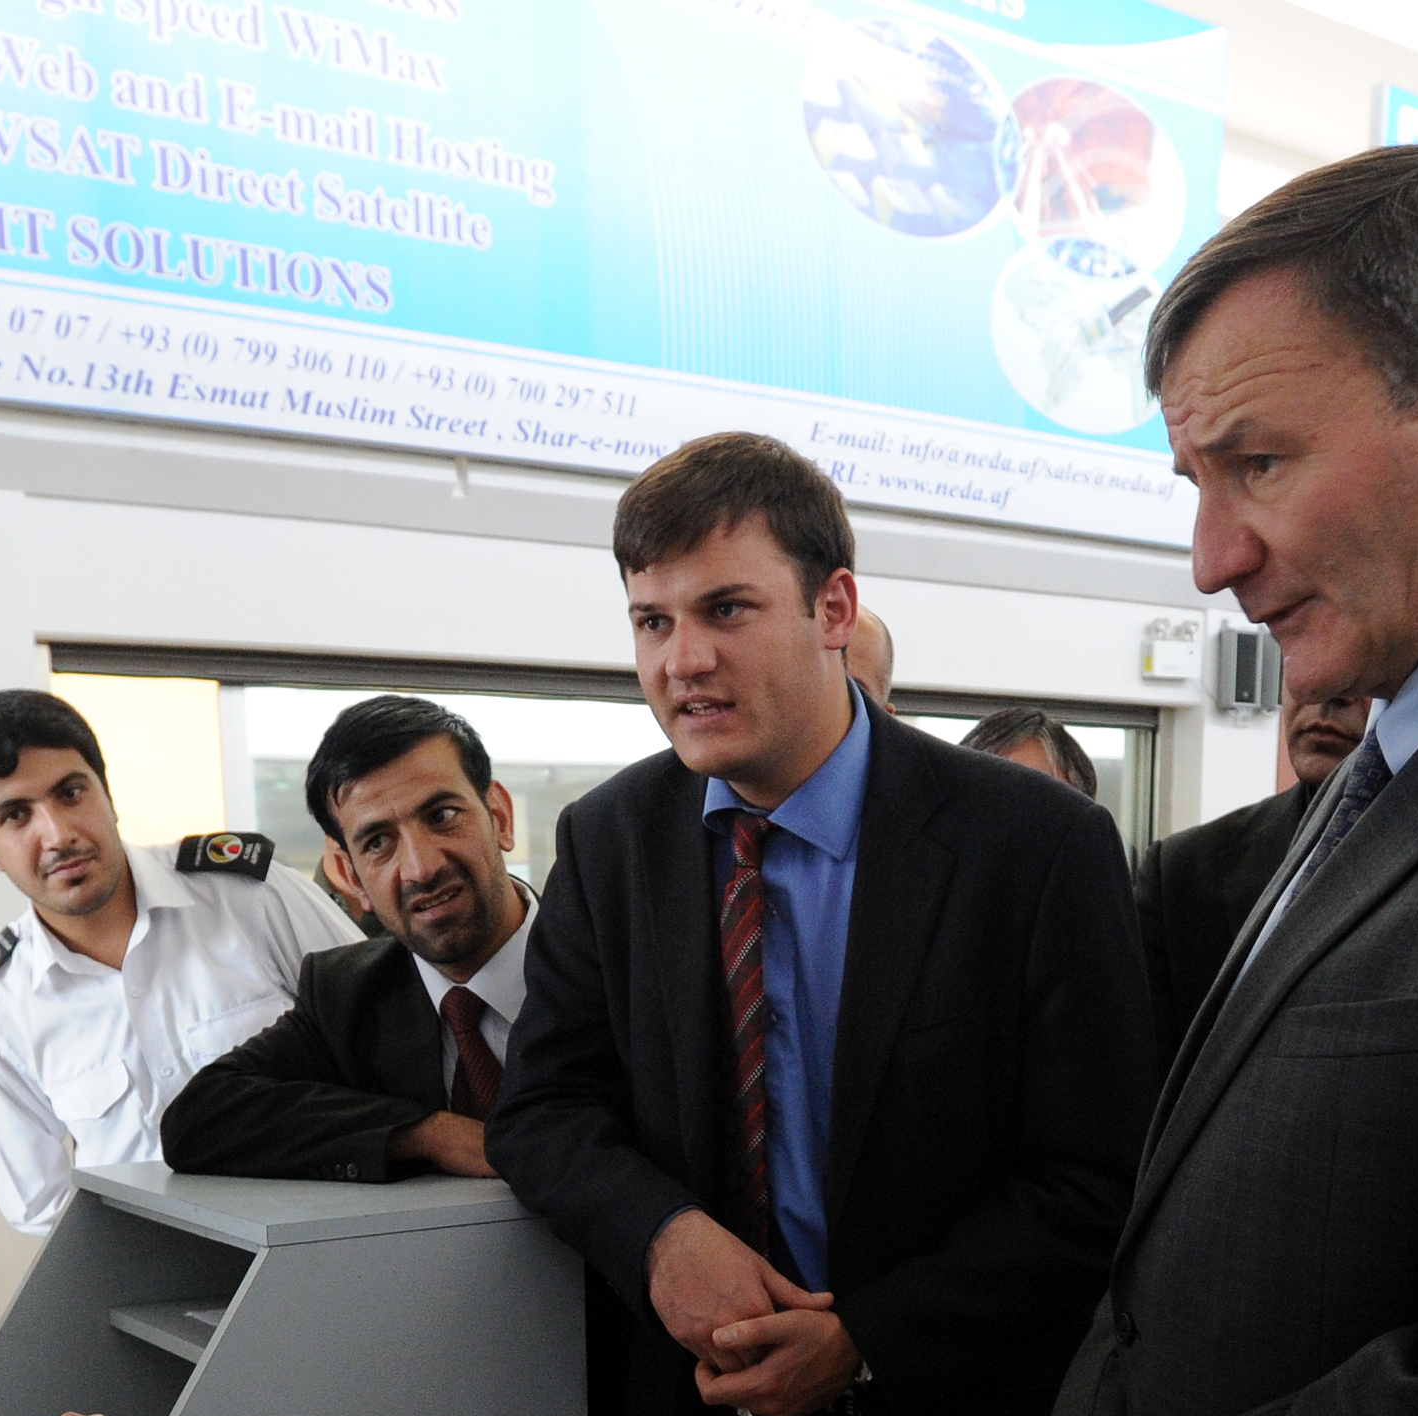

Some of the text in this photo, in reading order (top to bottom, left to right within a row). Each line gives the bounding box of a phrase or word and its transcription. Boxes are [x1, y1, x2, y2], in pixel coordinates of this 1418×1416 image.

[281, 8, 445, 88] WiMax
[115, 75, 204, 120] and
[221, 83, 375, 153] E-mail
[390, 120, 553, 202] Hosting
[154, 144, 302, 212] Direct
[318, 175, 489, 246] Satellite
[71, 217, 390, 309] SOLUTIONS
[9, 306, 44, 334] 07
[54, 313, 90, 341] 07
[120, 324, 171, 353] +93
[182, 331, 220, 362] (0)
[233, 336, 279, 366] 799
[287, 343, 334, 375] 306
[345, 352, 387, 382] 110
[412, 363, 456, 392] +93
[464, 371, 497, 402] (0)
[506, 377, 547, 405] 700
[554, 384, 595, 408] 297
[601, 391, 638, 417] 511
[167, 373, 271, 411] Esmat
[280, 386, 397, 427] Muslim
[406, 402, 490, 437] Street
[810, 420, 894, 454] E-mail:
[879, 471, 1015, 510] www.neda.af
